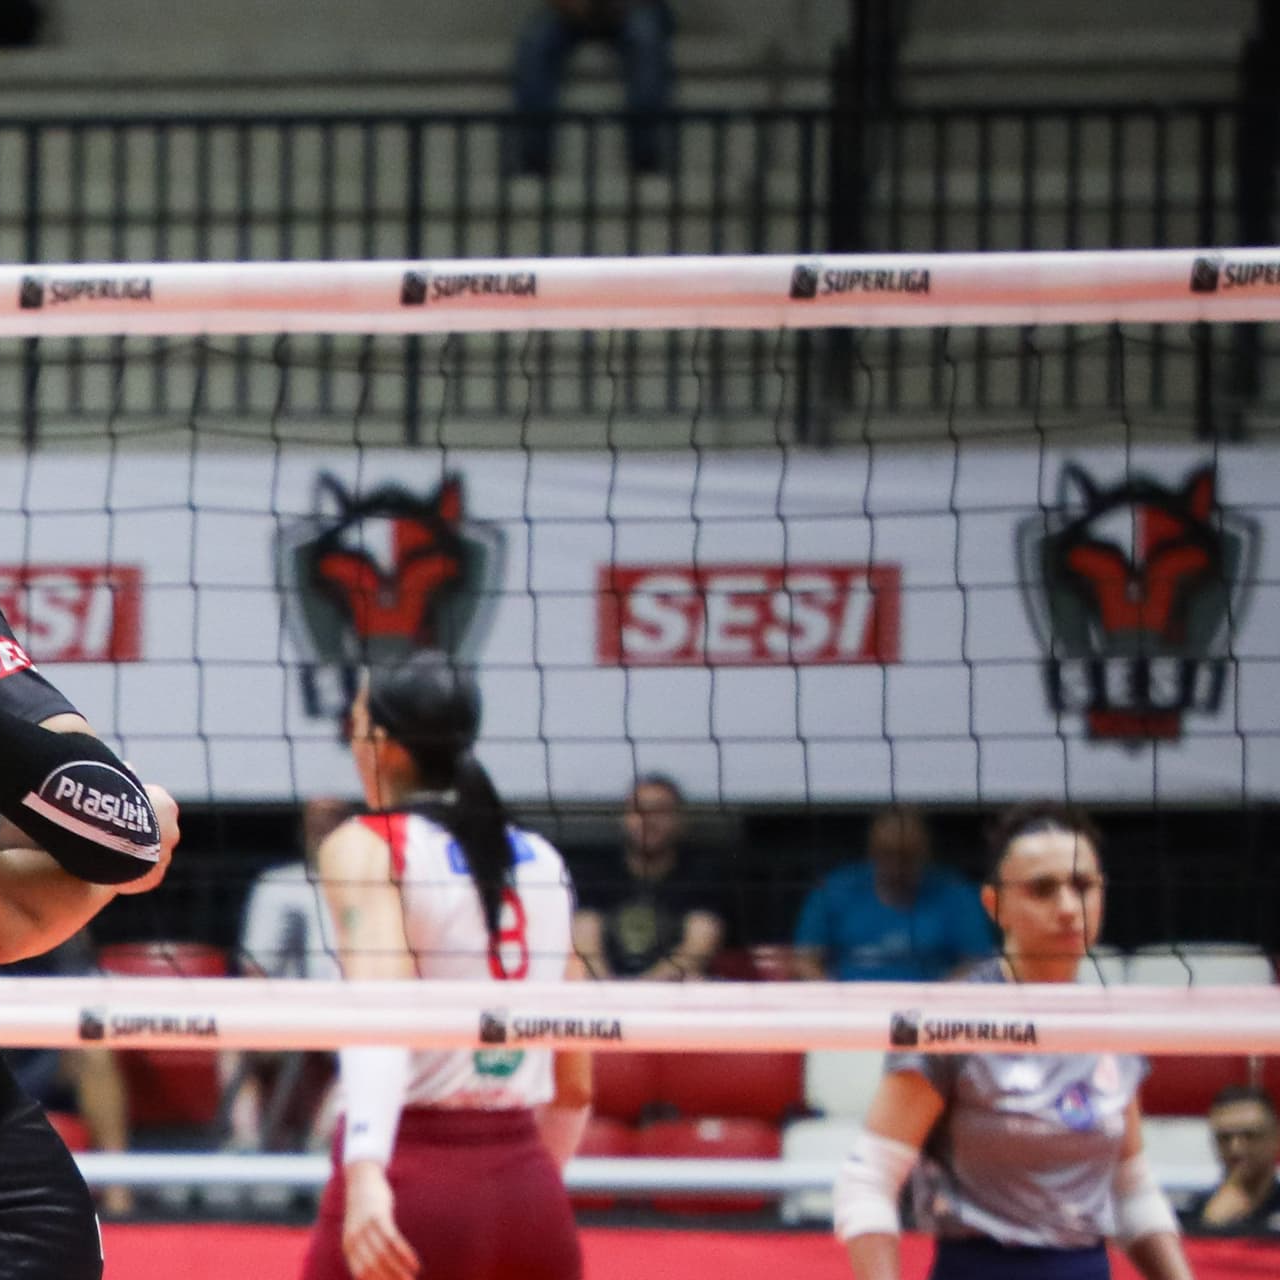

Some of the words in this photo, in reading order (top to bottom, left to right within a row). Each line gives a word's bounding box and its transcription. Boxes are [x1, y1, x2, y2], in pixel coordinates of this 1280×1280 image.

[50, 277, 153, 303] SUPERLIGA
[431, 272, 537, 298] SUPERLIGA
[822, 269, 930, 294] SUPERLIGA
[621, 574, 876, 656] SESI
[110, 1015, 219, 1037] SUPERLIGA
[513, 1018, 622, 1042] SUPERLIGA
[924, 1020, 1038, 1045] SUPERLIGA
